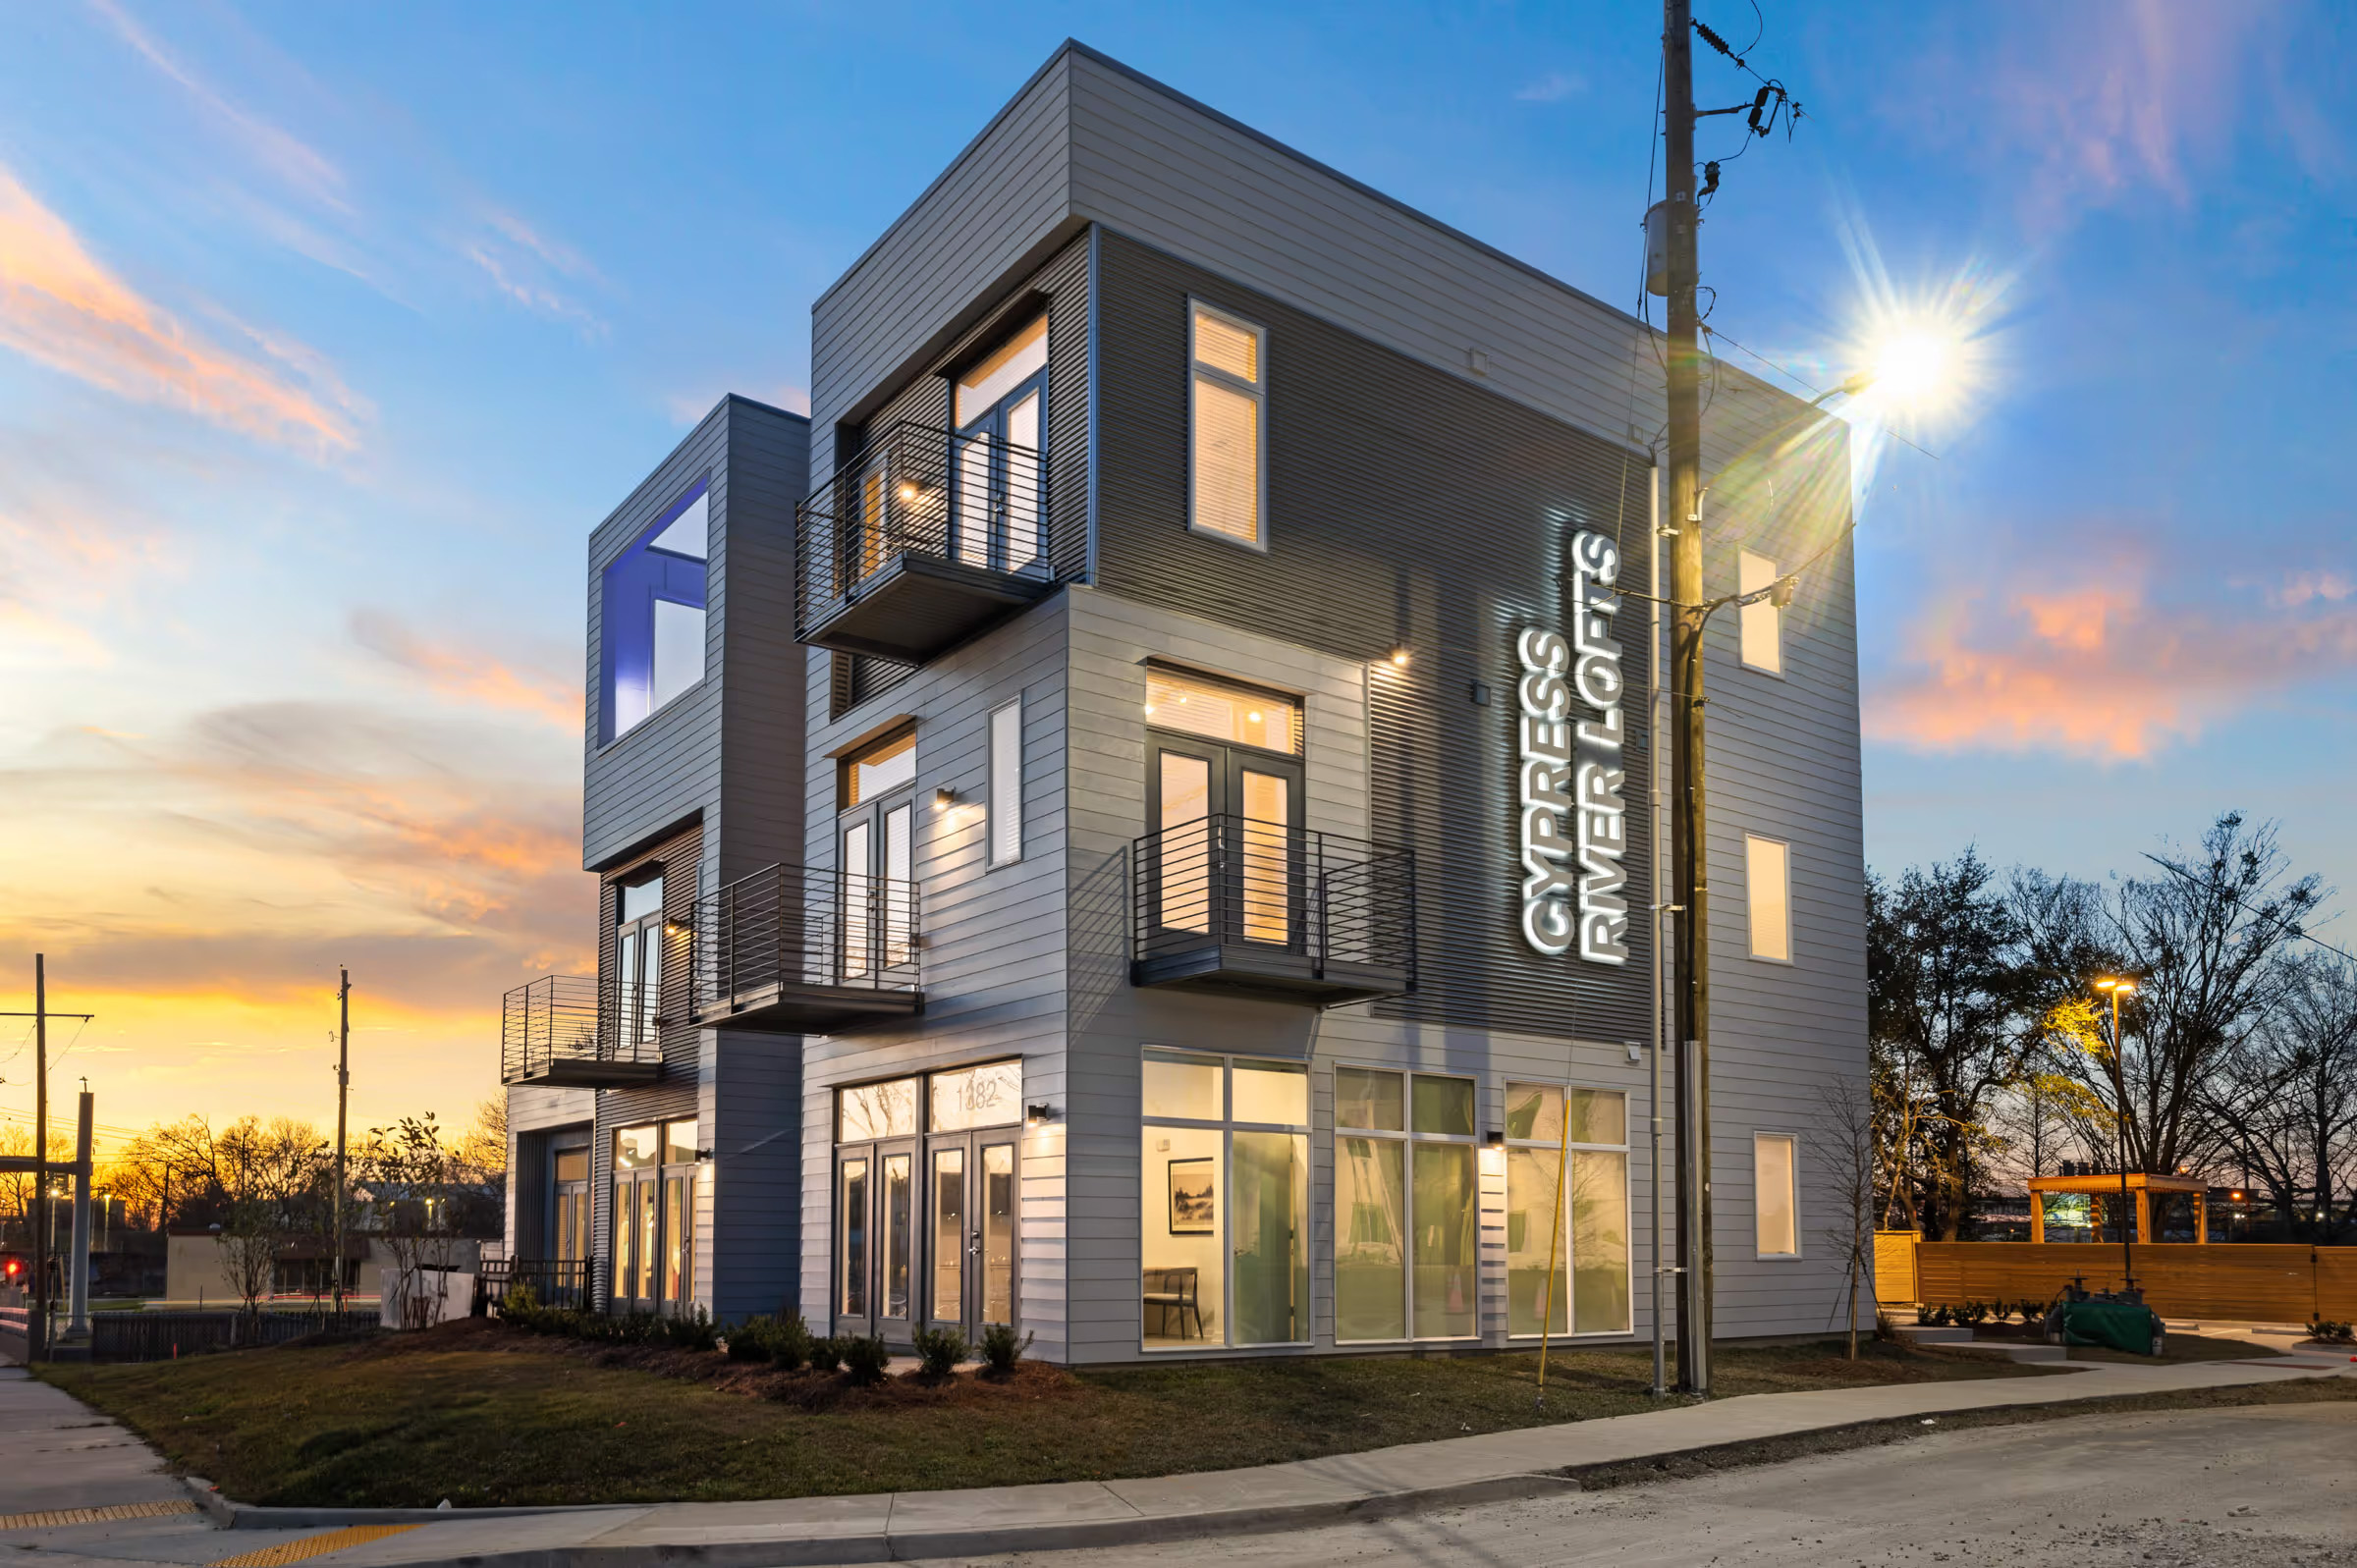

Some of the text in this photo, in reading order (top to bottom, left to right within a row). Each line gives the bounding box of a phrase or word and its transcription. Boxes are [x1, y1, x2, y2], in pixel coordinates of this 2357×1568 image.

[1518, 626, 1575, 954] CYPRESS
[1572, 530, 1629, 965] RIVER LOFTS
